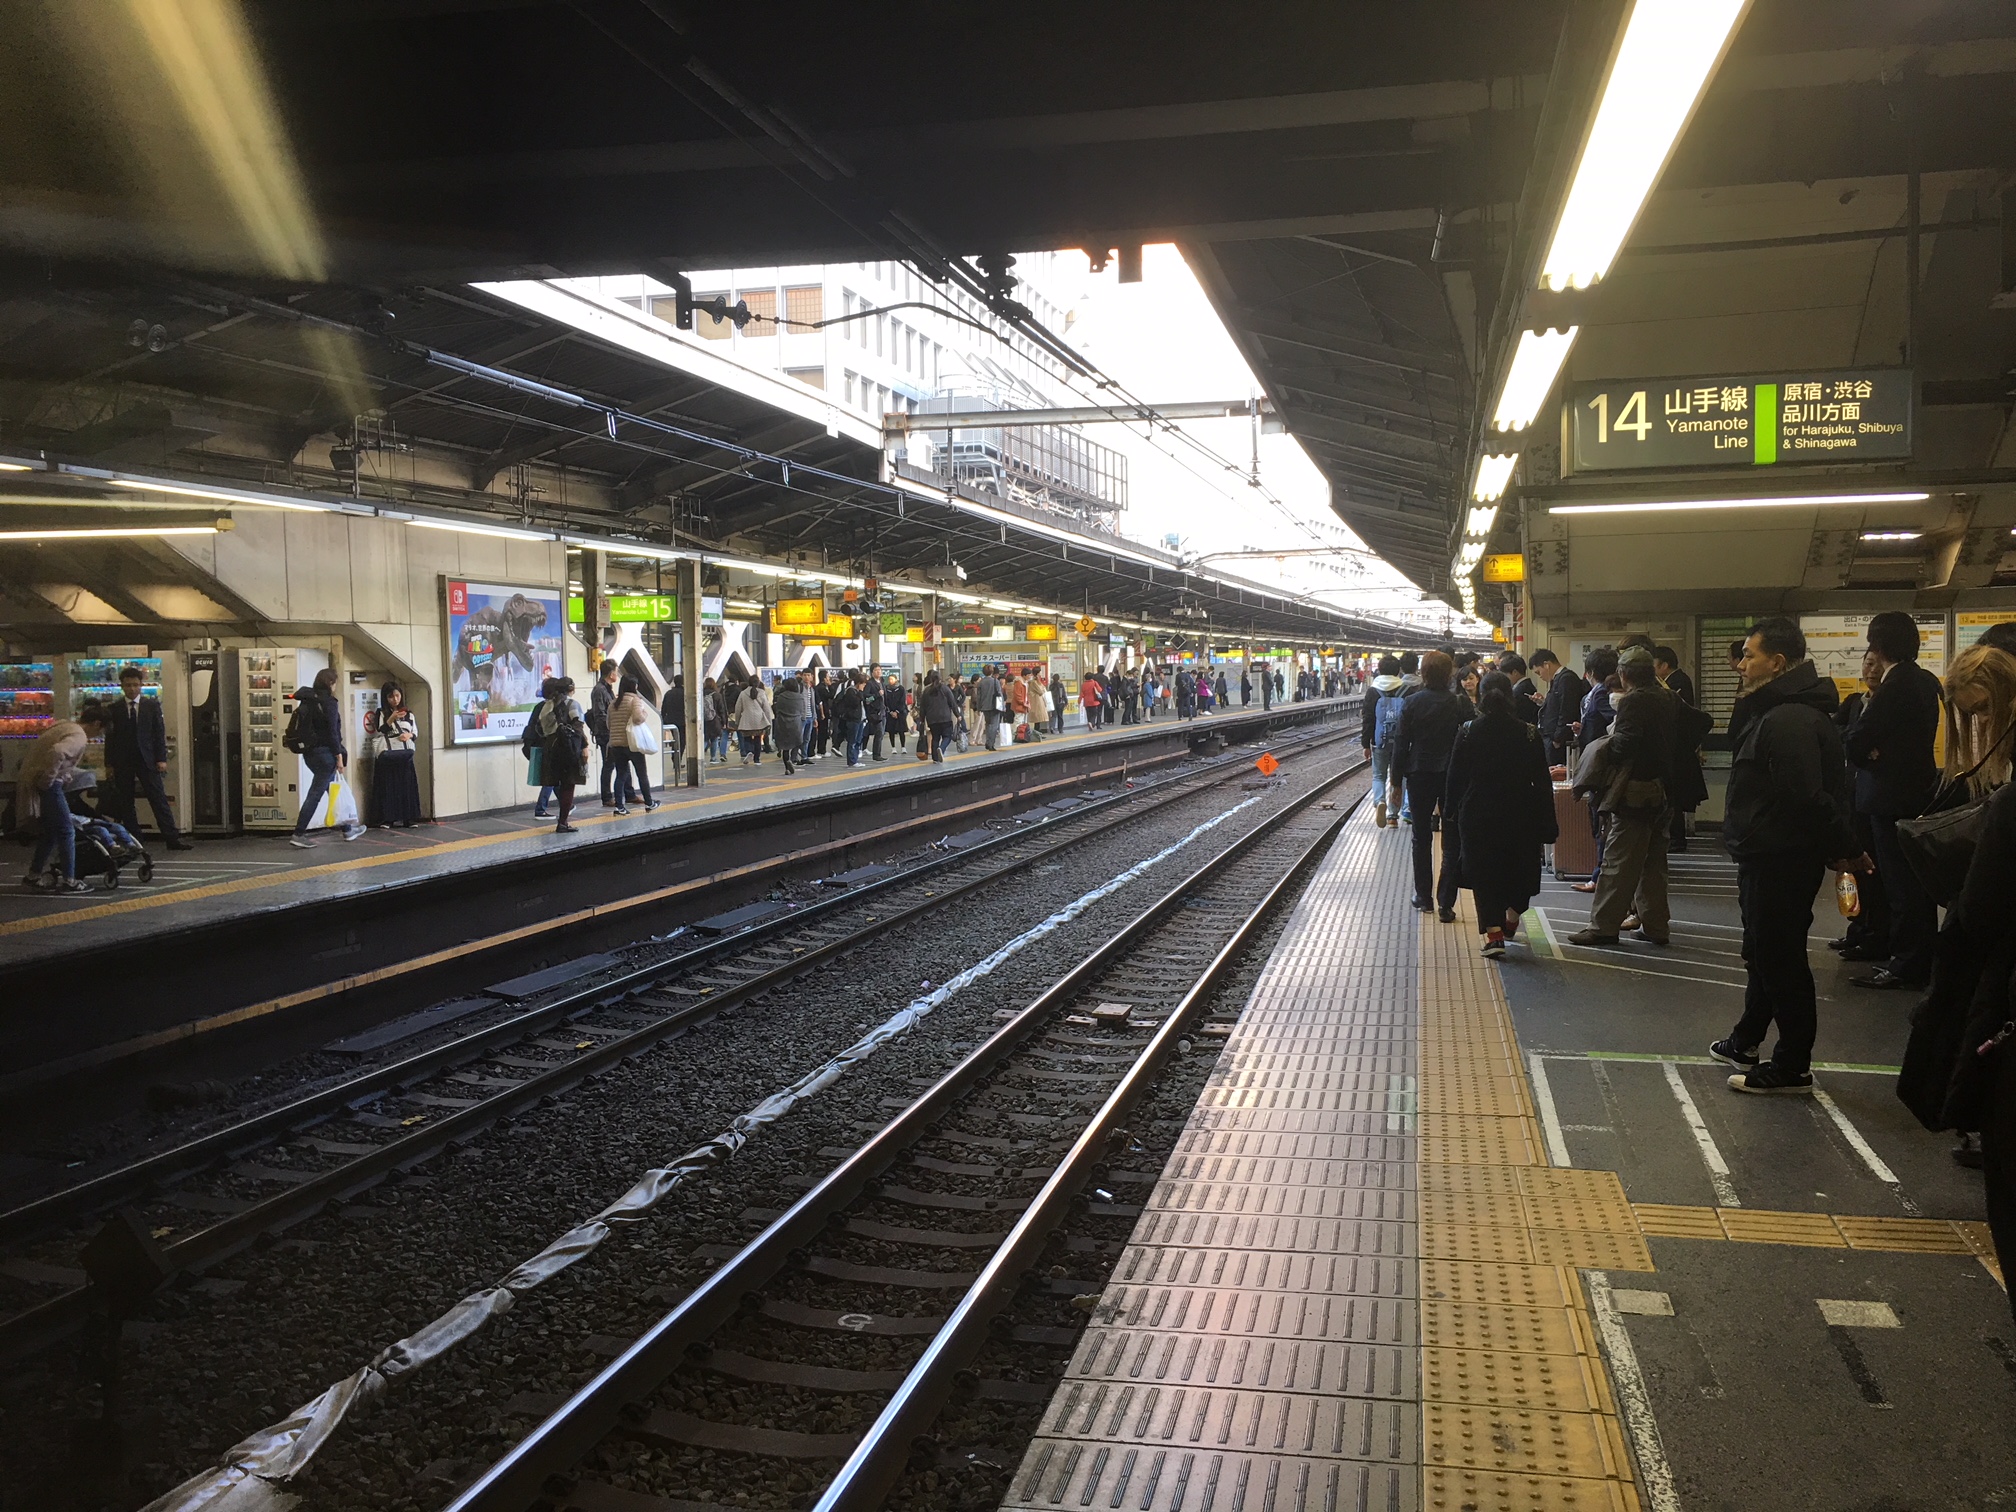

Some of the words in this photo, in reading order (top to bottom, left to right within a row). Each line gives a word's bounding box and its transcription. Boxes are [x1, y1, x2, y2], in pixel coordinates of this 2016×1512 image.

[1783, 380, 1872, 401] 原宿・渋谷
[1664, 386, 1748, 415] 山手線
[1587, 391, 1652, 443] 14
[1783, 402, 1860, 423] 品川方面
[1666, 418, 1748, 433] Yamanote
[1783, 425, 1799, 436] for
[1801, 423, 1855, 437] Harajuku,
[1858, 422, 1903, 435] Shibuya
[1714, 434, 1748, 449] Line
[1783, 439, 1792, 449] &
[1794, 437, 1857, 450] Shinagawa
[622, 599, 648, 609] 山手線
[650, 598, 672, 618] 15
[498, 719, 515, 728] 10.27
